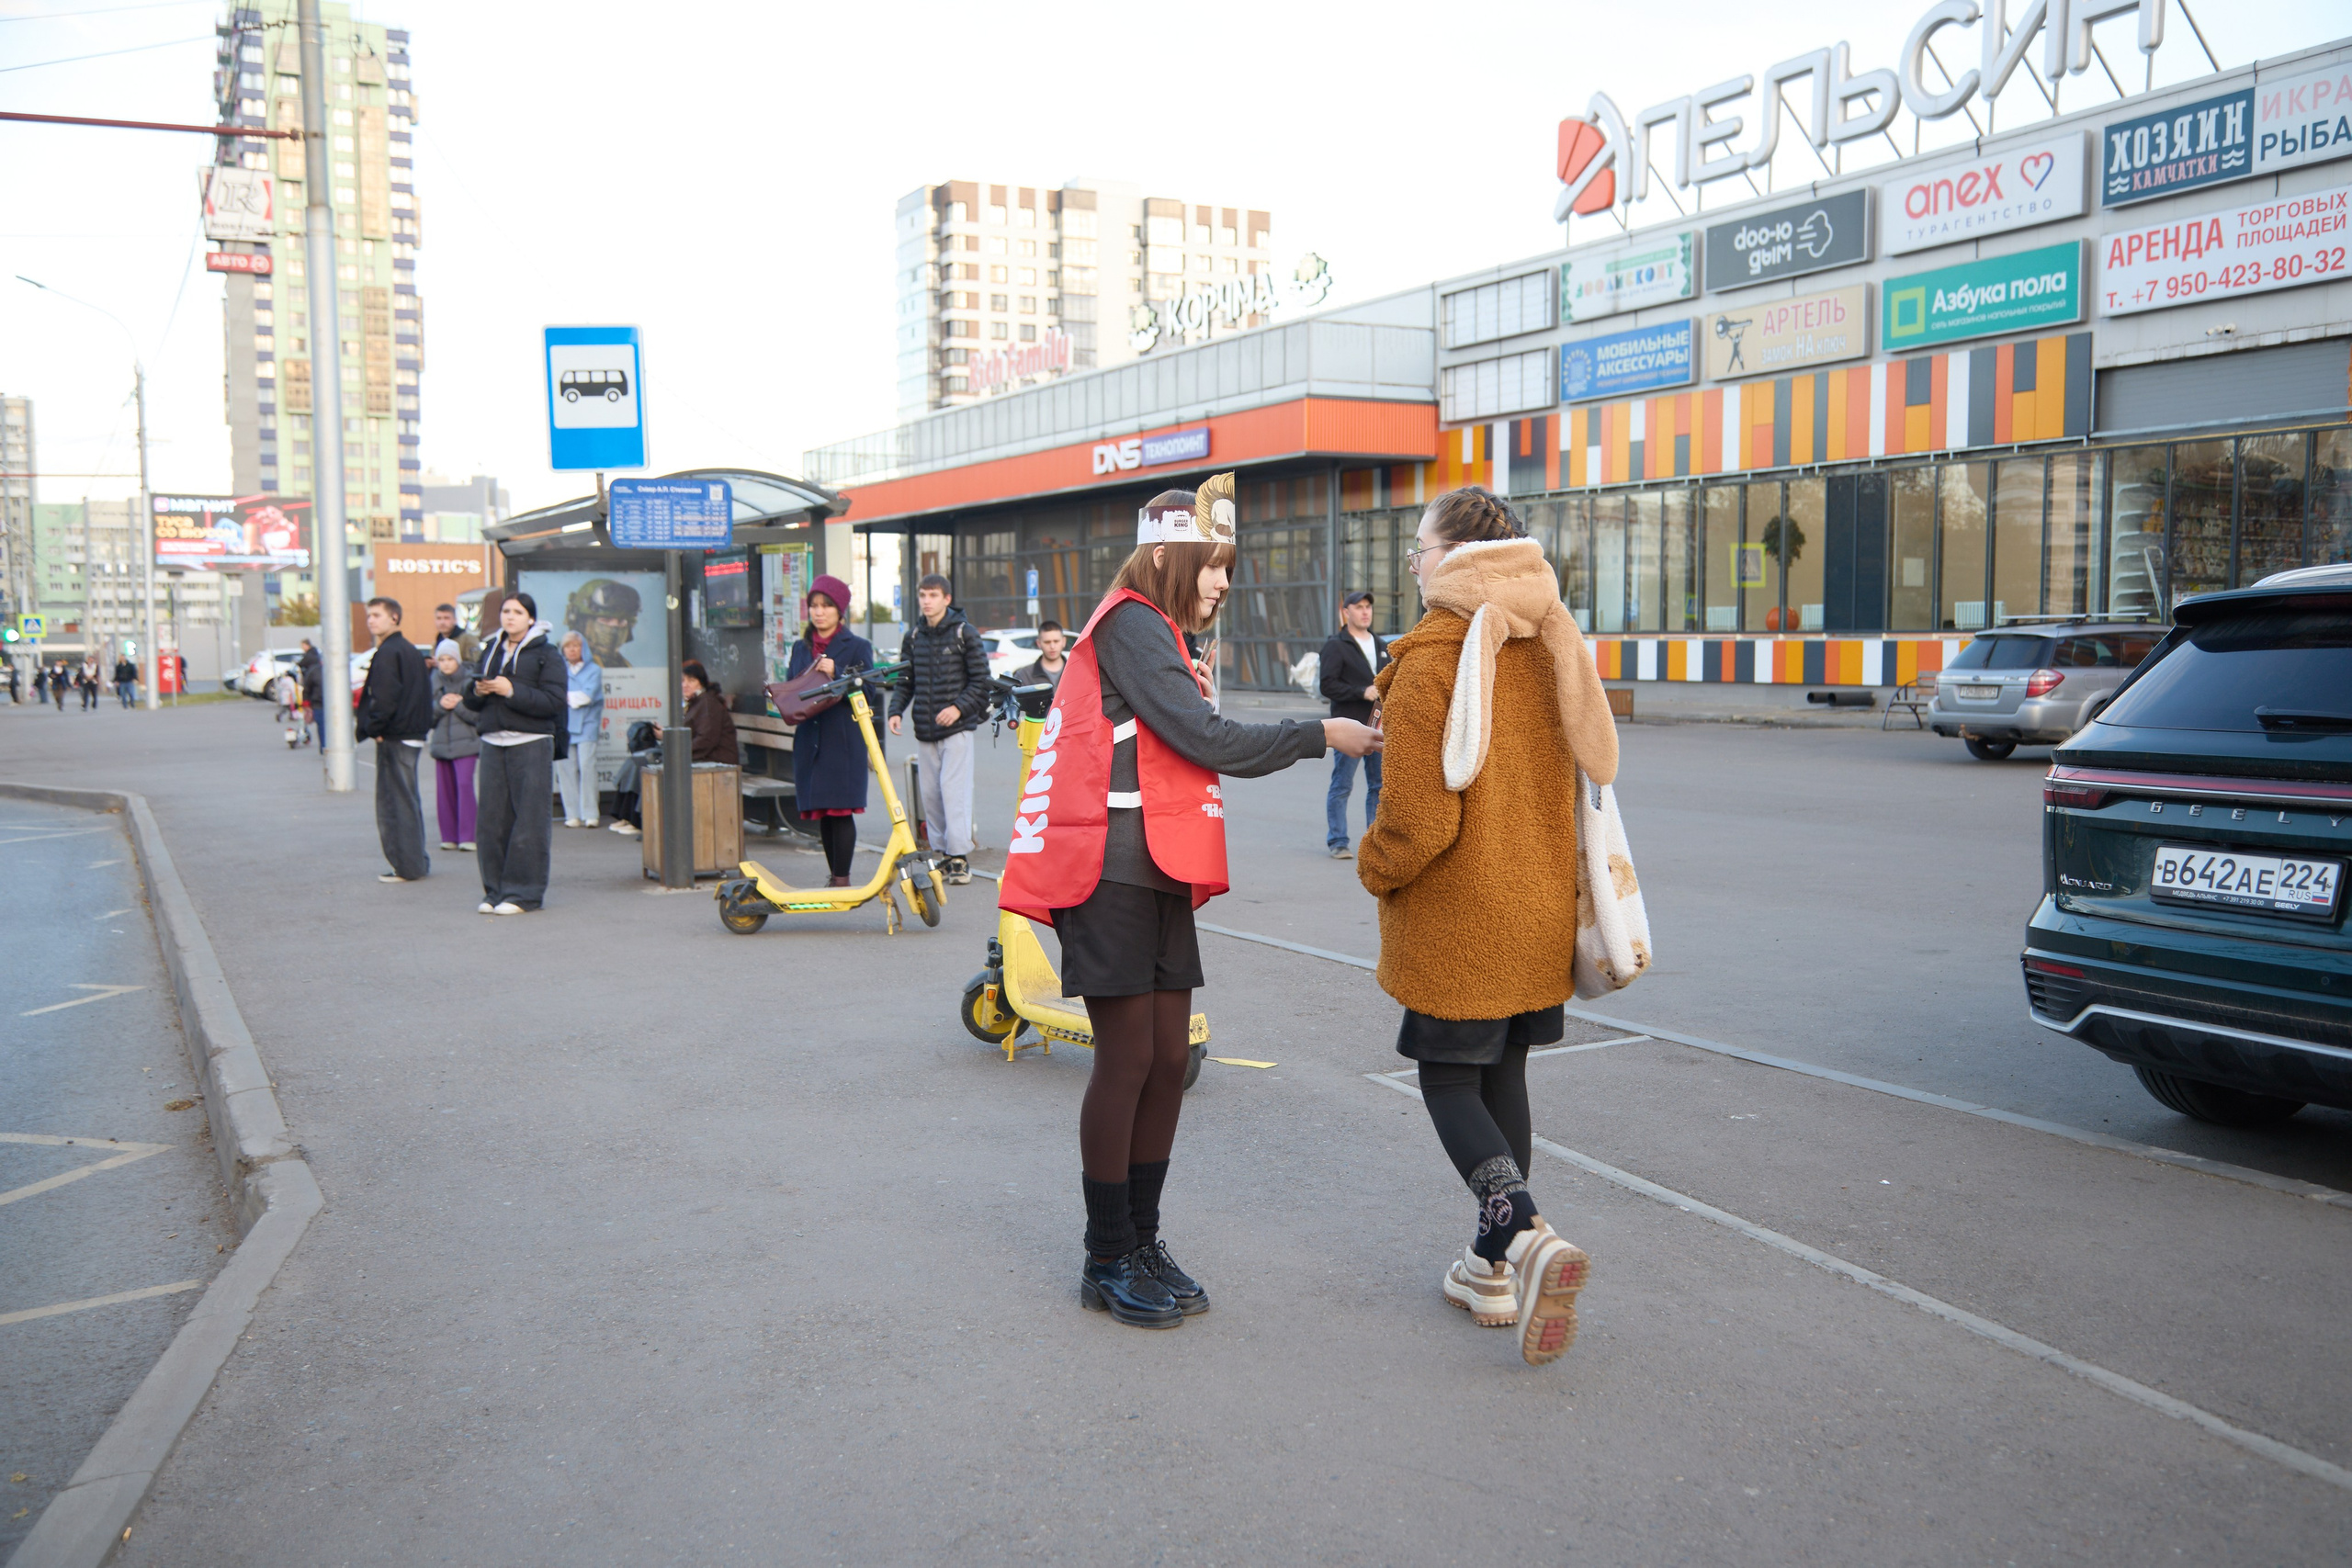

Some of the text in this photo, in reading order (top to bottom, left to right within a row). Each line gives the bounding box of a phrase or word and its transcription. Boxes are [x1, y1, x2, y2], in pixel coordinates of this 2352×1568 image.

[2262, 74, 2352, 121] ИКРА
[2109, 100, 2246, 174] ХОЗЯИН
[2260, 115, 2352, 162] РЫБА
[1905, 163, 2004, 220] anex
[2132, 153, 2218, 191] КАМЧАТКИ
[1907, 198, 2052, 240] ТУРАГЕНТСТВО
[2237, 209, 2346, 249] ПЛОЩАДЕЙ
[2238, 192, 2347, 228] ТОРГОВЫХ
[2108, 217, 2223, 270] АРЕНДА
[1931, 271, 2066, 314] Азбука пола
[2132, 280, 2158, 305] +7
[2166, 247, 2346, 299] 950-423-80-32
[1165, 274, 1279, 339] КОРЧМА
[1763, 298, 1846, 337] АРТЕЛЬ
[968, 327, 1074, 391] Rich Family
[1597, 330, 1690, 361] МОБИЛЬНЫЕ
[1597, 348, 1689, 378] АКСЕССУАРЫ
[1796, 334, 1815, 358] НА
[1093, 433, 1206, 475] DNS ТЕХНОПОИНТ
[388, 558, 481, 574] ROSTIC'S
[1009, 707, 1062, 853] KING
[2150, 801, 2345, 828] GEELY
[2172, 889, 2196, 898] МЕДВЕДЬ
[2196, 892, 2218, 901] АЛЬЯНС
[2230, 896, 2239, 904] 391
[2240, 897, 2250, 905] 219
[2280, 863, 2329, 892] 224
[2288, 889, 2312, 902] RUS
[2274, 901, 2300, 910] GEELY
